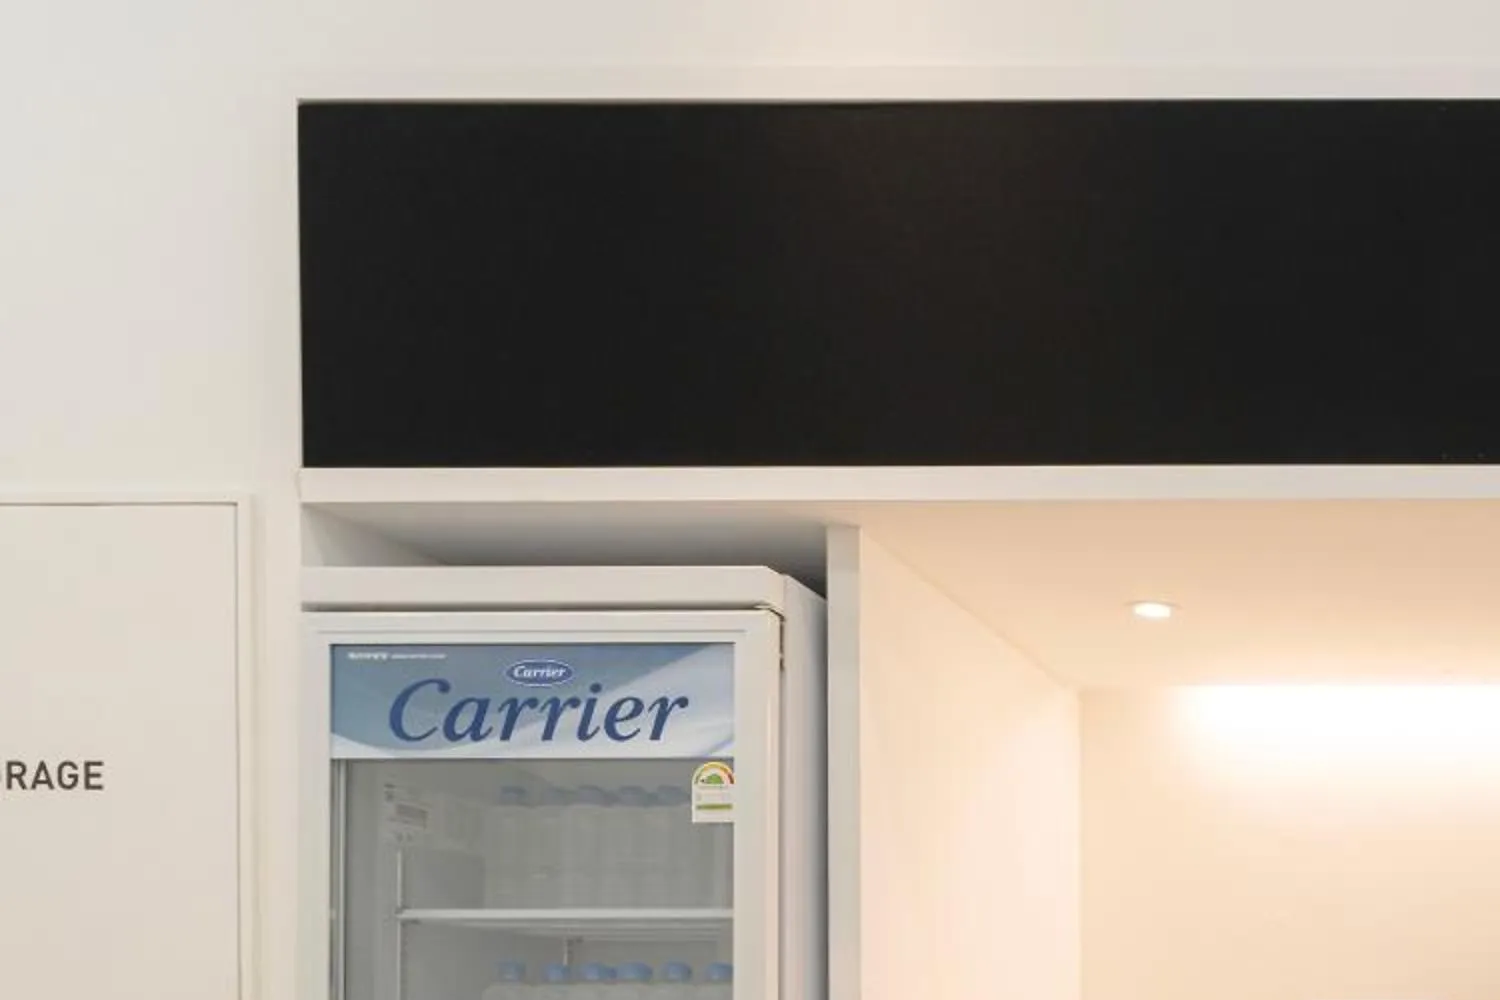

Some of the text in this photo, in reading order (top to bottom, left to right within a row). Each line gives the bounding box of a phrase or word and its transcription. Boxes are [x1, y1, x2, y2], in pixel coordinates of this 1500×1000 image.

[513, 665, 568, 678] Carrier
[388, 677, 689, 742] Carrier
[0, 760, 105, 791] RAGE
